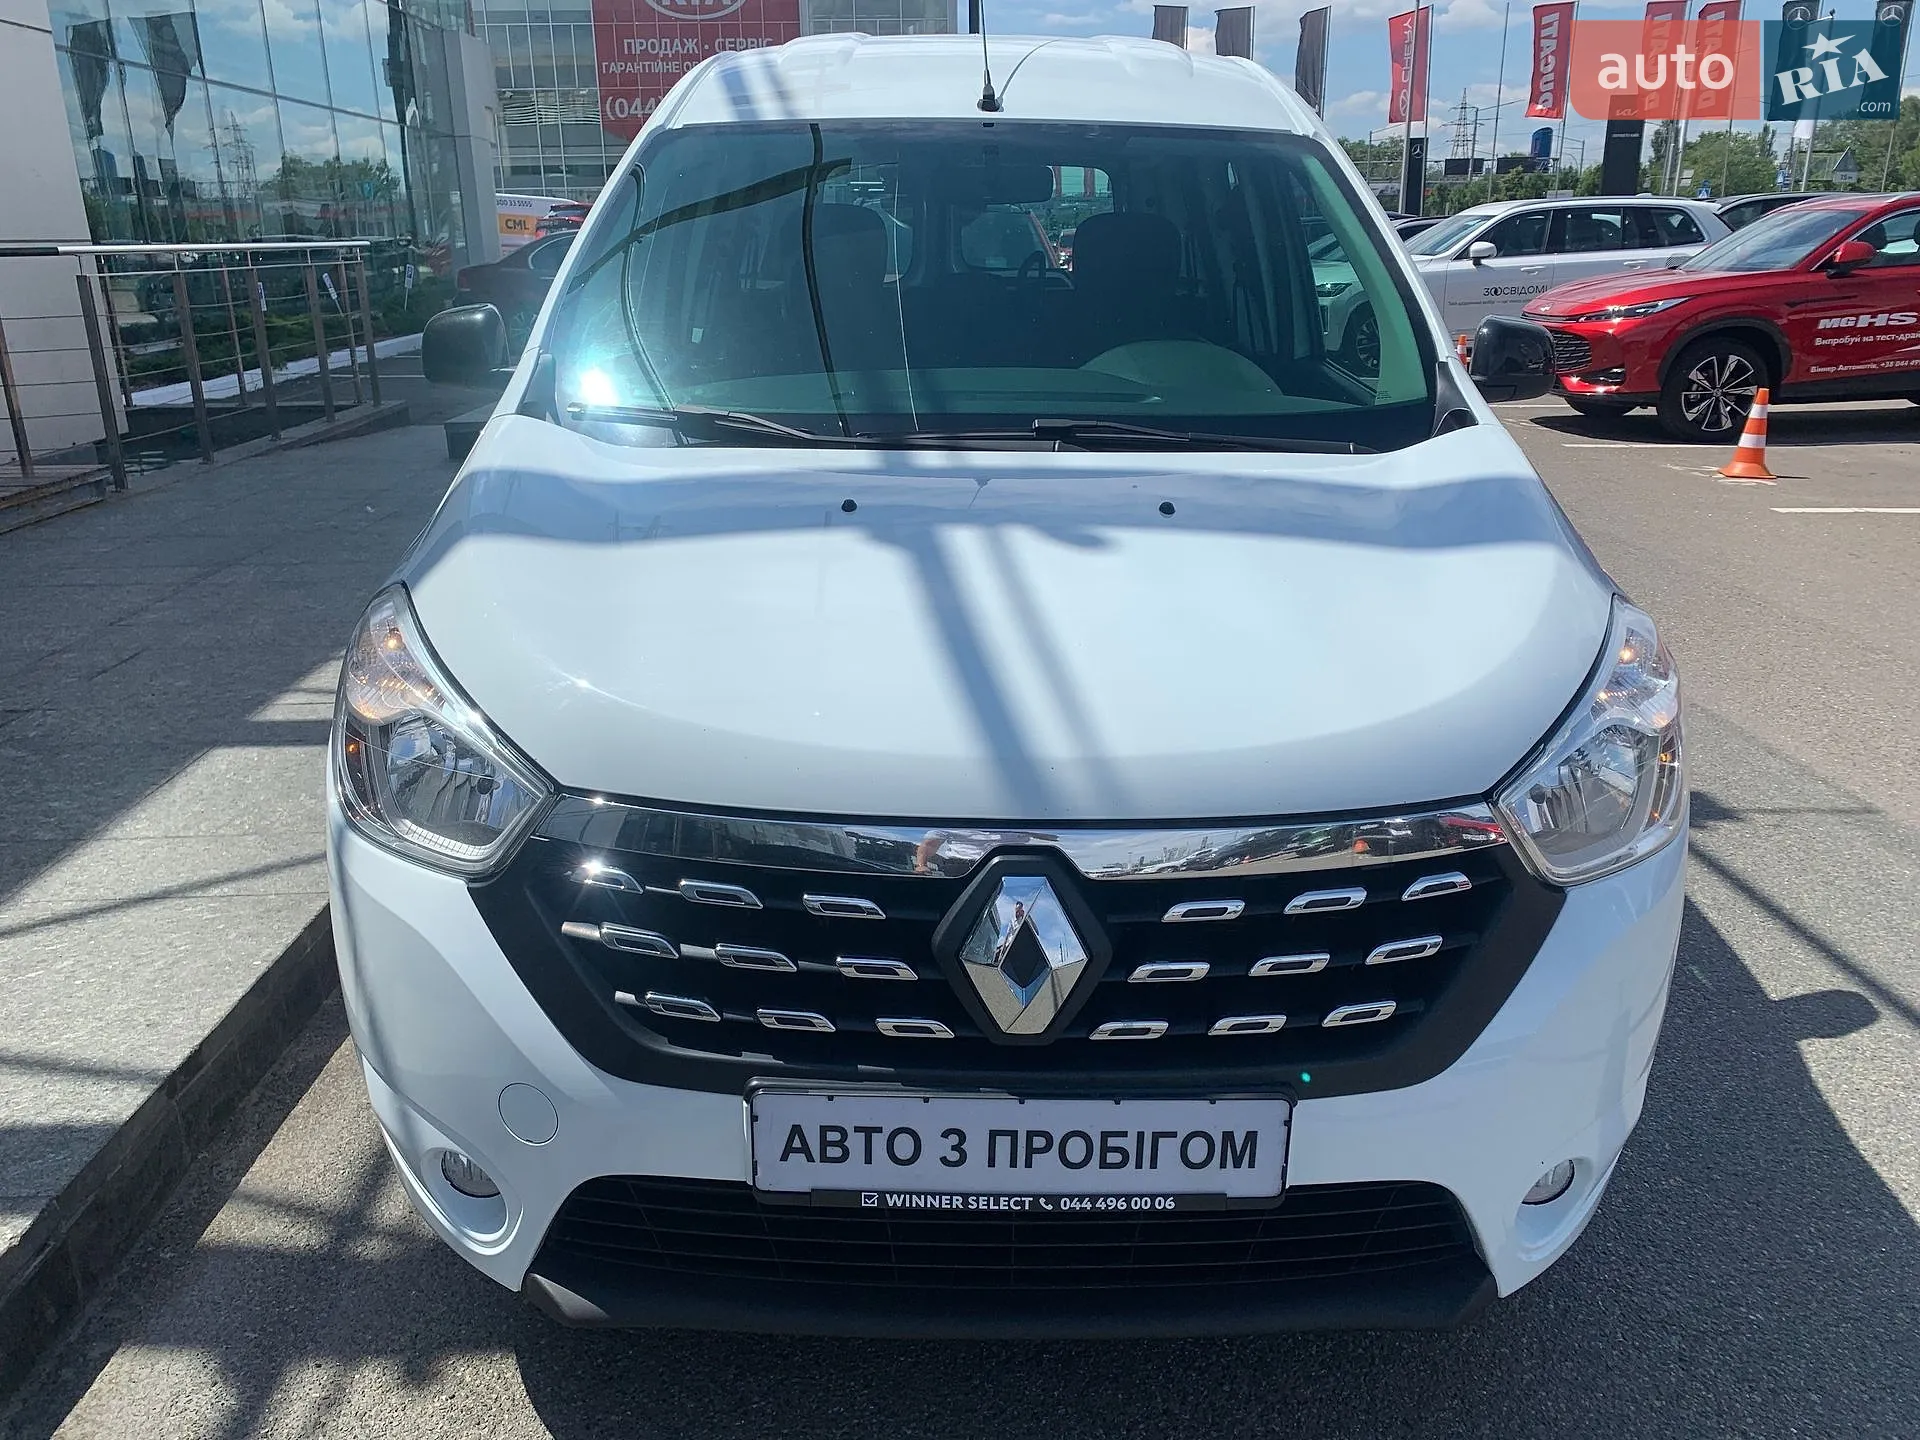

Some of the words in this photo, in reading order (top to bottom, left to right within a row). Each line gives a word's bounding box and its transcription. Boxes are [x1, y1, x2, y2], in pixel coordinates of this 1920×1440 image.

[624, 38, 699, 57] ПРОДАЖ
[602, 61, 680, 74] ГАРАНТІЙНЕ
[505, 218, 530, 231] CML
[1815, 334, 1860, 346] Випробуй
[779, 1124, 922, 1167] АВТО
[987, 1129, 1258, 1170] ПРОБІГОМ
[886, 1193, 963, 1210] WINNER
[968, 1195, 1033, 1210] SELECT
[1060, 1196, 1092, 1210] 044
[1095, 1197, 1127, 1210] 496
[1131, 1197, 1151, 1210] 00
[1154, 1196, 1176, 1210] 06
